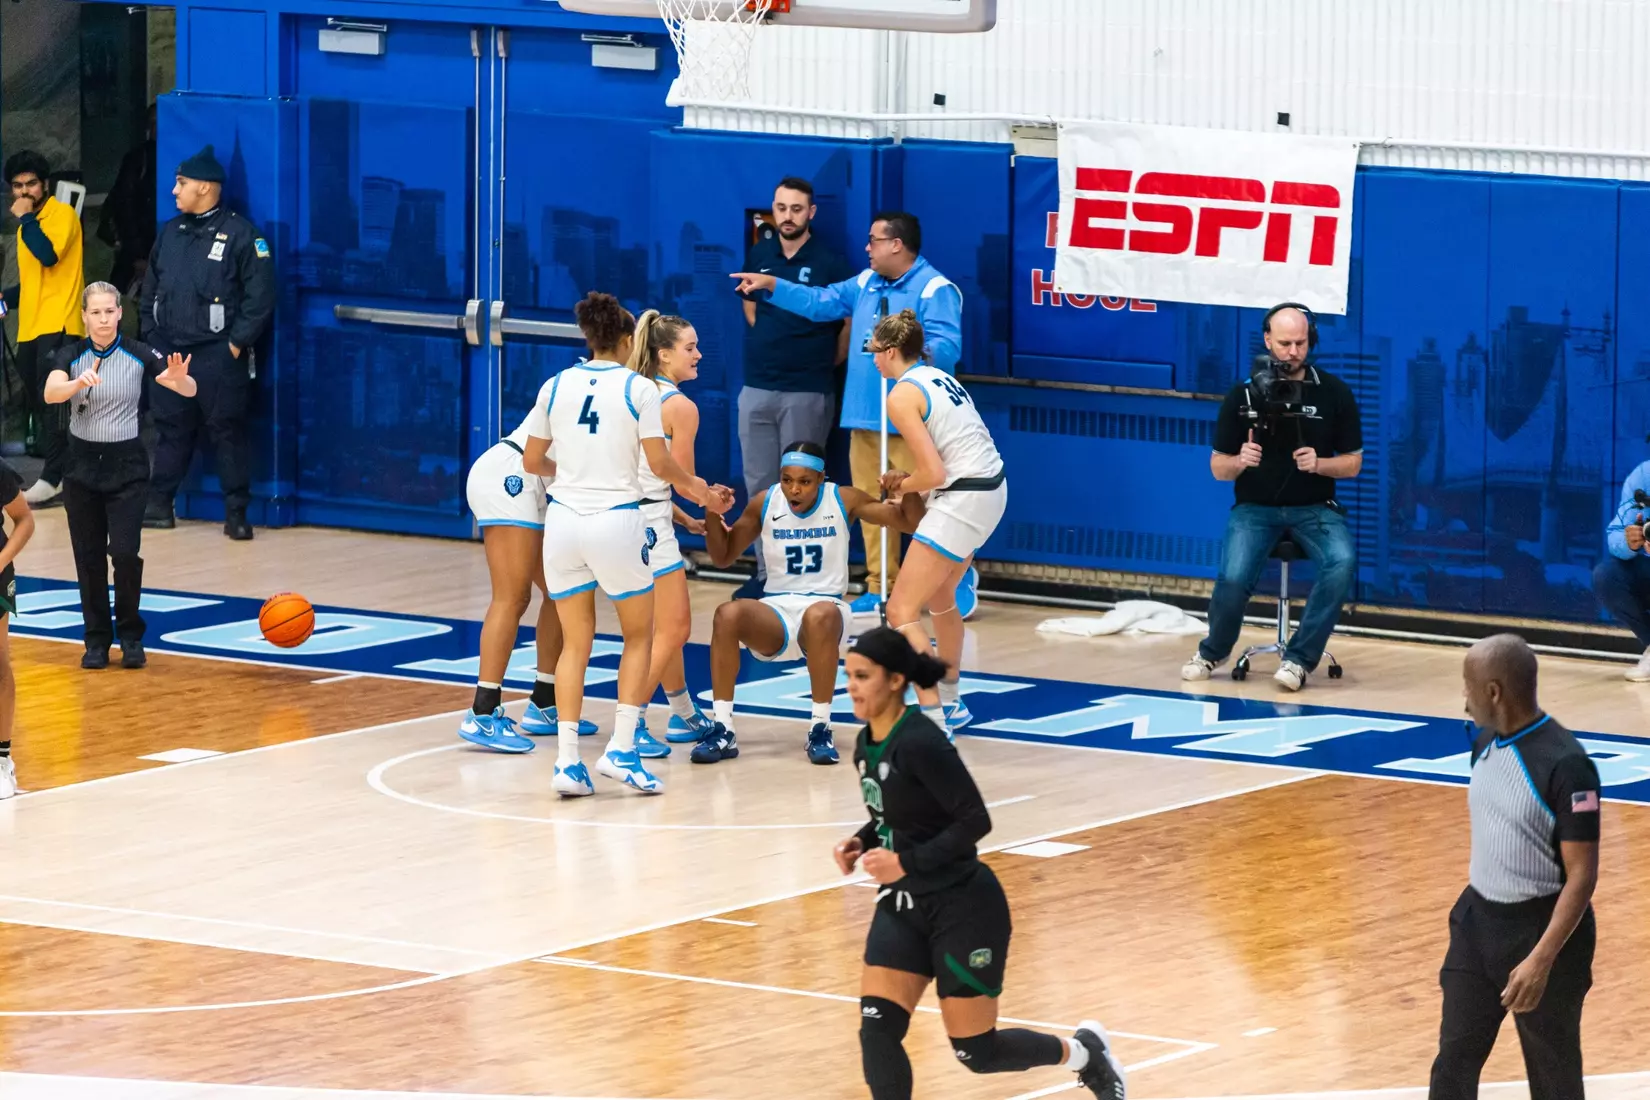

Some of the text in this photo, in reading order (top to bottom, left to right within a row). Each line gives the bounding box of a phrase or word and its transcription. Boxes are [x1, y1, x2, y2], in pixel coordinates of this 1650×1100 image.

[1068, 166, 1340, 266] ESPN
[798, 266, 812, 283] C
[577, 394, 600, 435] 4
[772, 526, 837, 540] COLUMBIA
[785, 544, 823, 575] 23
